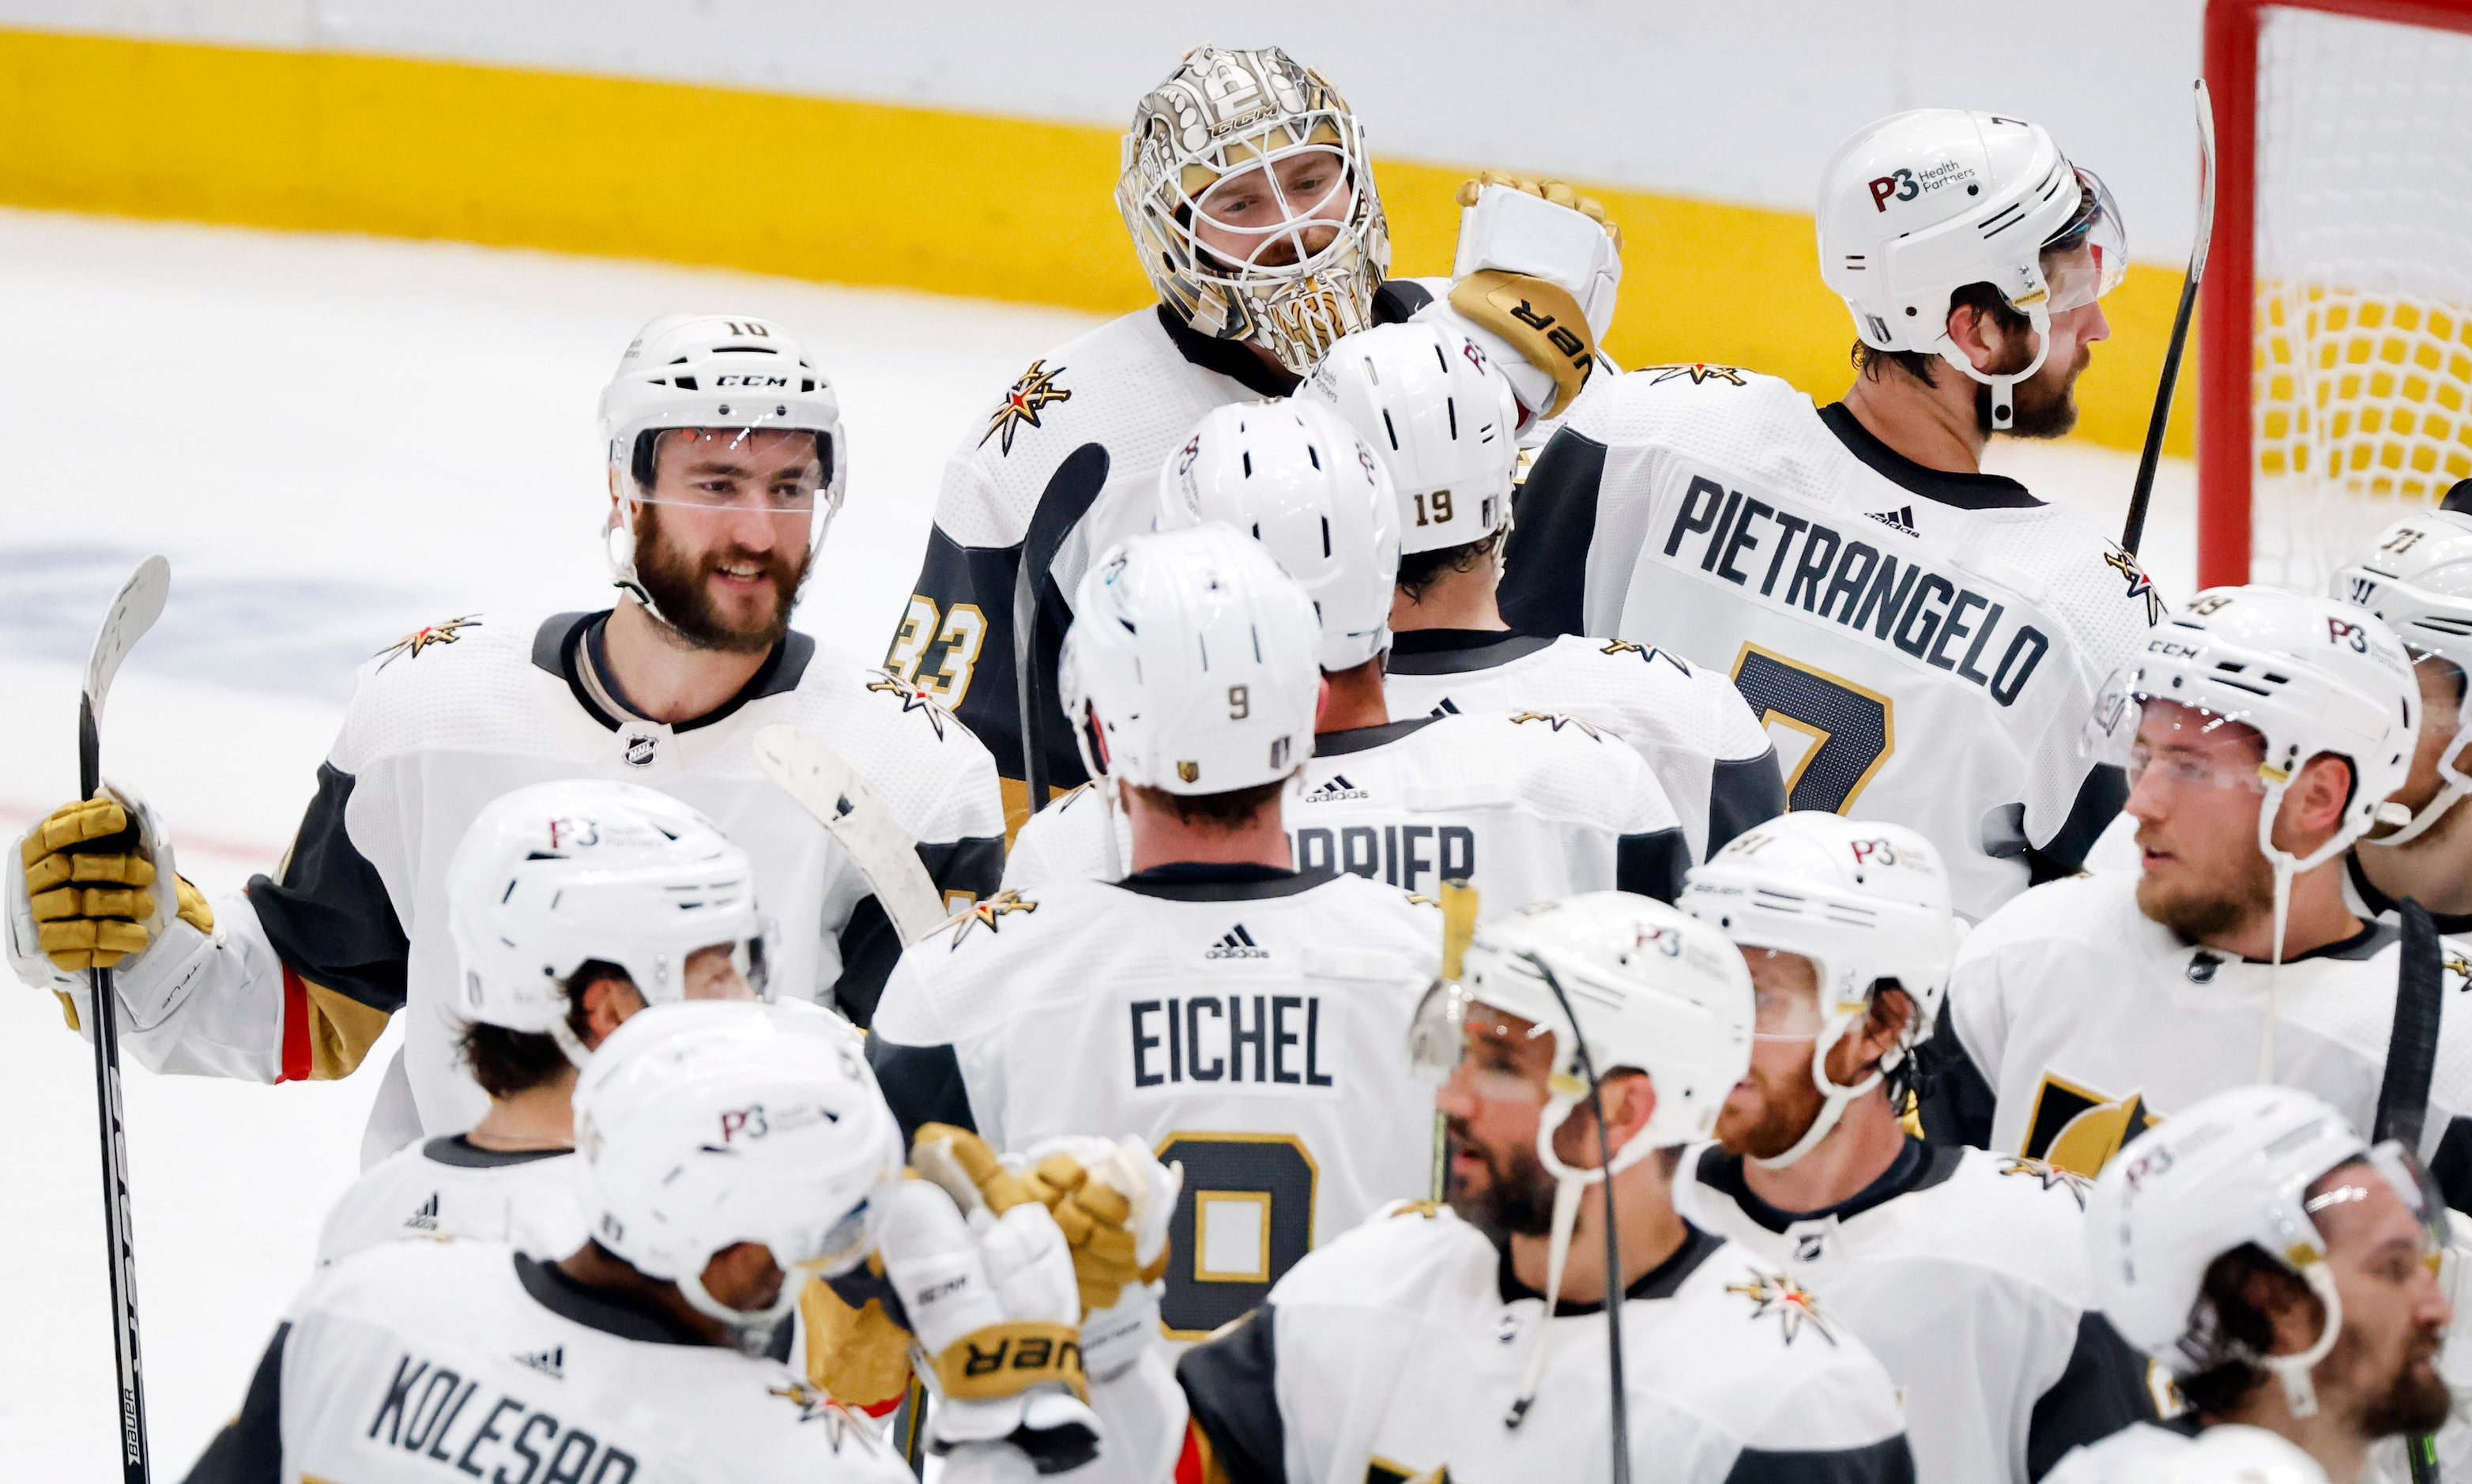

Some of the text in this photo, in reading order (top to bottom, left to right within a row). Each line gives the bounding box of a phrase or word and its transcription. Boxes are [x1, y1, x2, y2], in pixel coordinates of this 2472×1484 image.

[1207, 101, 1280, 137] CCM
[1868, 160, 1961, 213] P3 Health
[1922, 167, 1976, 193] Partners
[724, 322, 770, 338] 10
[716, 375, 789, 387] CCM
[1414, 489, 1453, 527] 19
[1863, 512, 1920, 539] adidas
[2380, 528, 2427, 555] 71
[1664, 474, 2049, 707] PIETRANGELO
[2147, 640, 2198, 659] CCM
[2327, 616, 2368, 653] P3
[887, 593, 989, 713] 33
[1227, 684, 1250, 721] 9
[1728, 640, 1896, 817] 7
[1306, 789, 1371, 804] adidas
[1850, 838, 1895, 866] P3
[1204, 947, 1270, 959] adidas
[1131, 995, 1332, 1087] EICHEL
